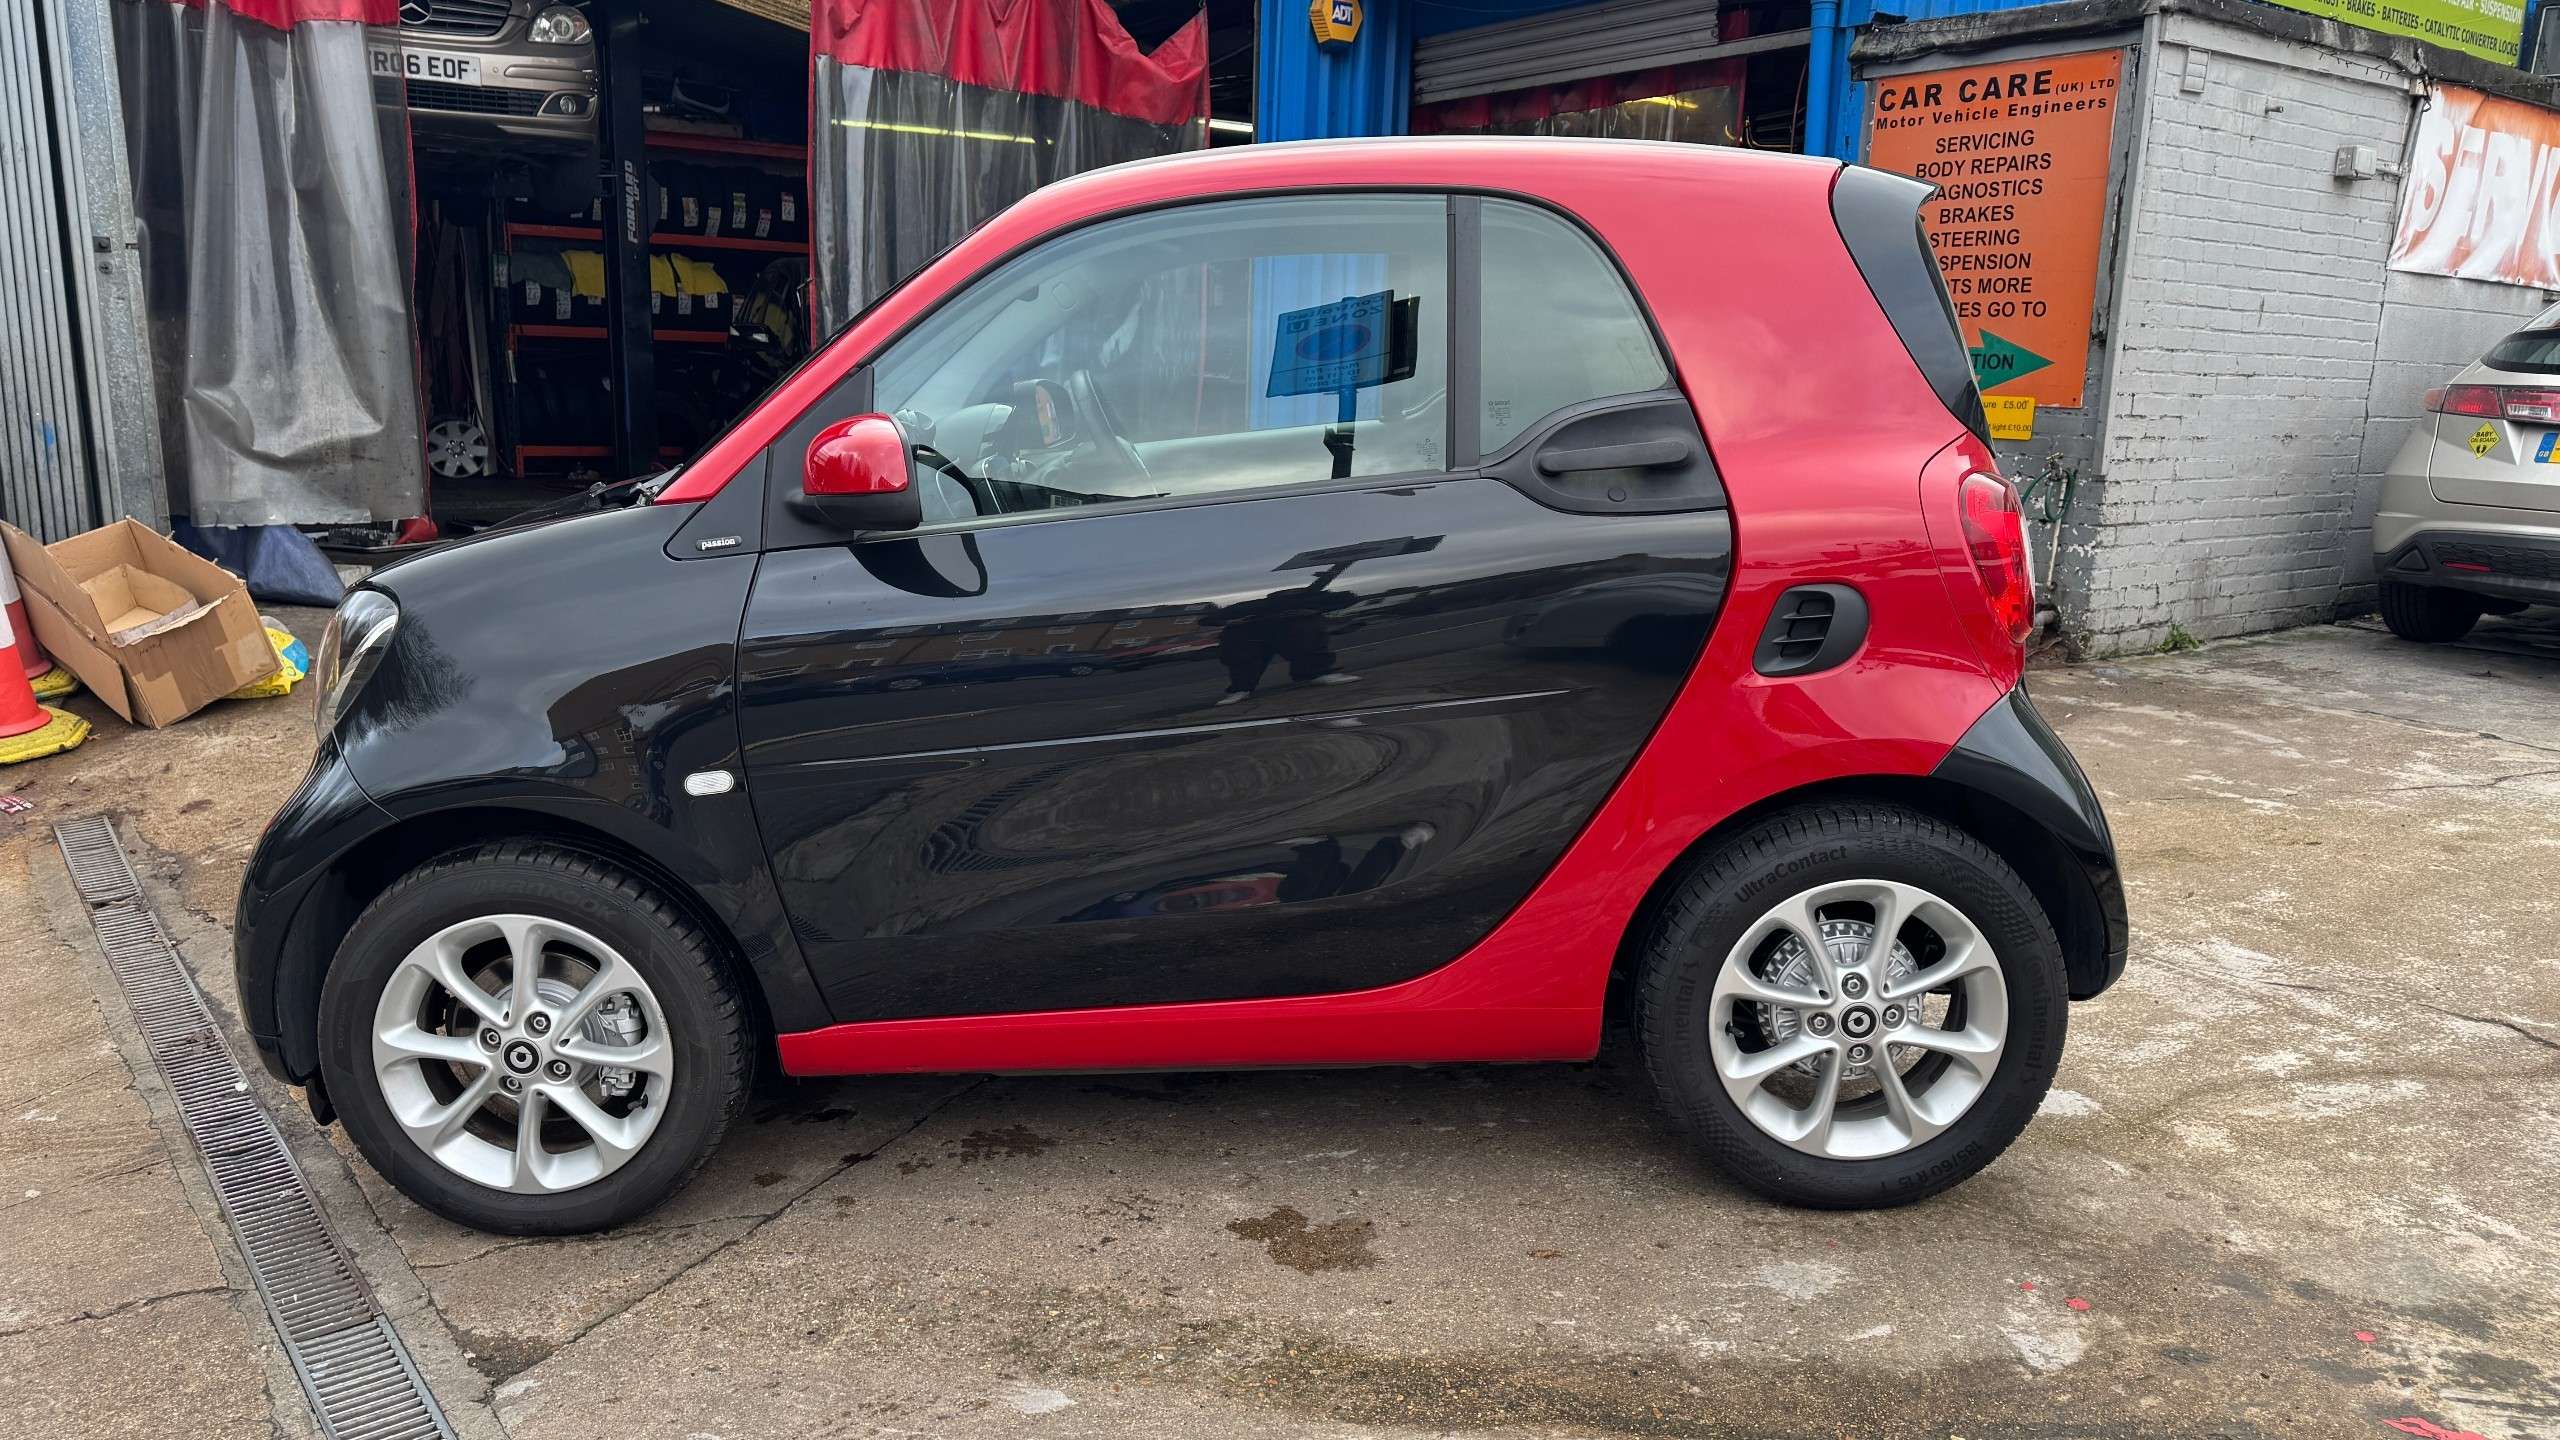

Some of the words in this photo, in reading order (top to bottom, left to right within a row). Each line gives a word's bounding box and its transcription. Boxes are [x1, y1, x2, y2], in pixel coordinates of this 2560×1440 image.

[1331, 4, 1354, 23] ADT
[2480, 0, 2523, 24] SUSPENSION
[2346, 0, 2376, 18] BRAKES
[2382, 6, 2420, 30] BATTERIES
[2424, 18, 2461, 41] CATALYTIC
[2461, 29, 2498, 51] CONVERTER
[2498, 39, 2519, 57] LOCKS
[427, 55, 470, 80] EOF
[1879, 83, 1943, 112] CAR
[1958, 69, 2054, 104] CARE
[2055, 81, 2084, 97] (UK)
[2089, 78, 2115, 91] LTD
[1876, 115, 1925, 131] Motor
[1932, 107, 1999, 125] Vehicle
[2007, 97, 2108, 118] Engineers
[1935, 129, 2035, 154] SERVICING
[1915, 159, 1966, 179] BODY
[1970, 152, 2053, 176] REPAIRS
[624, 159, 639, 244] FORWARD
[1932, 178, 2044, 202] AGNOSTICS
[1939, 204, 2015, 225] BRAKES
[1929, 228, 2021, 249] STEERING
[1938, 252, 2032, 272] SPENSION
[1977, 277, 2034, 295] MORE
[1987, 301, 2016, 318] GO
[2021, 301, 2047, 318] TO
[701, 538, 736, 550] passion
[1734, 845, 1848, 903] UltraContact
